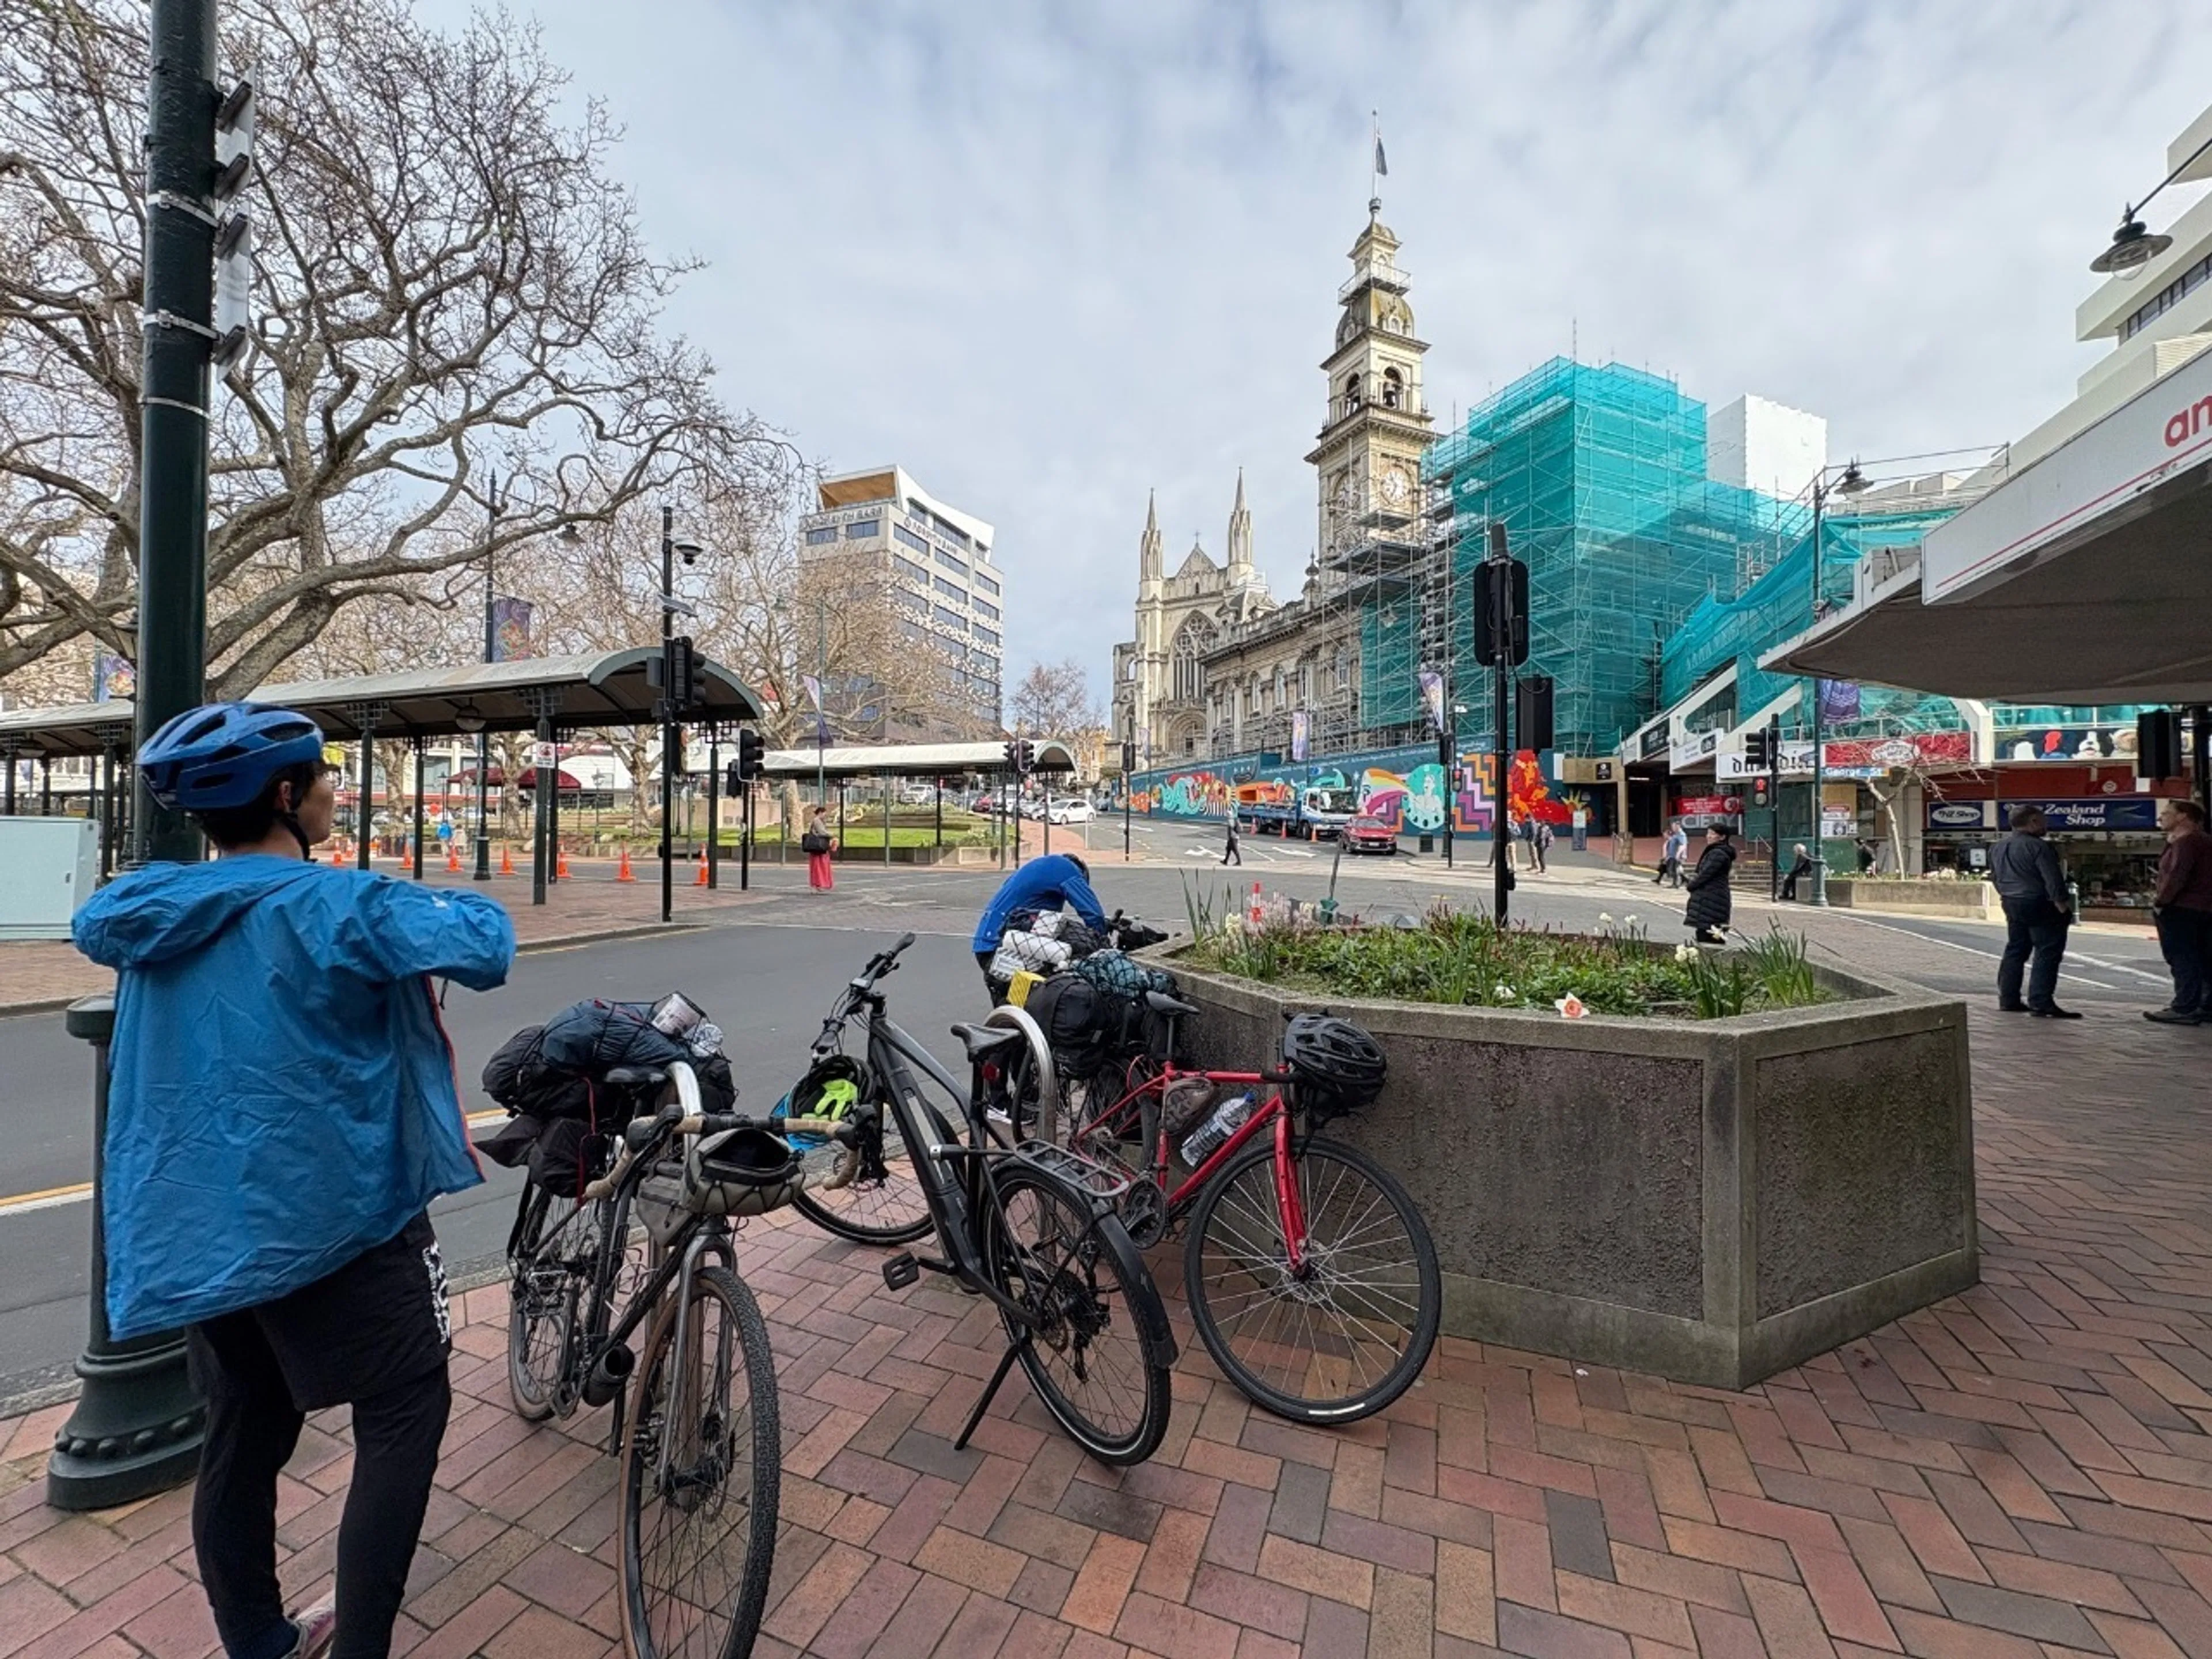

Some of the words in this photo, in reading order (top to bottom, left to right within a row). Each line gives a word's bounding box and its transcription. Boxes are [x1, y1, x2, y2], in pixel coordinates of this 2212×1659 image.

[1825, 767, 1860, 778] George
[2045, 804, 2106, 815] Zealand
[2065, 814, 2106, 826] Shop
